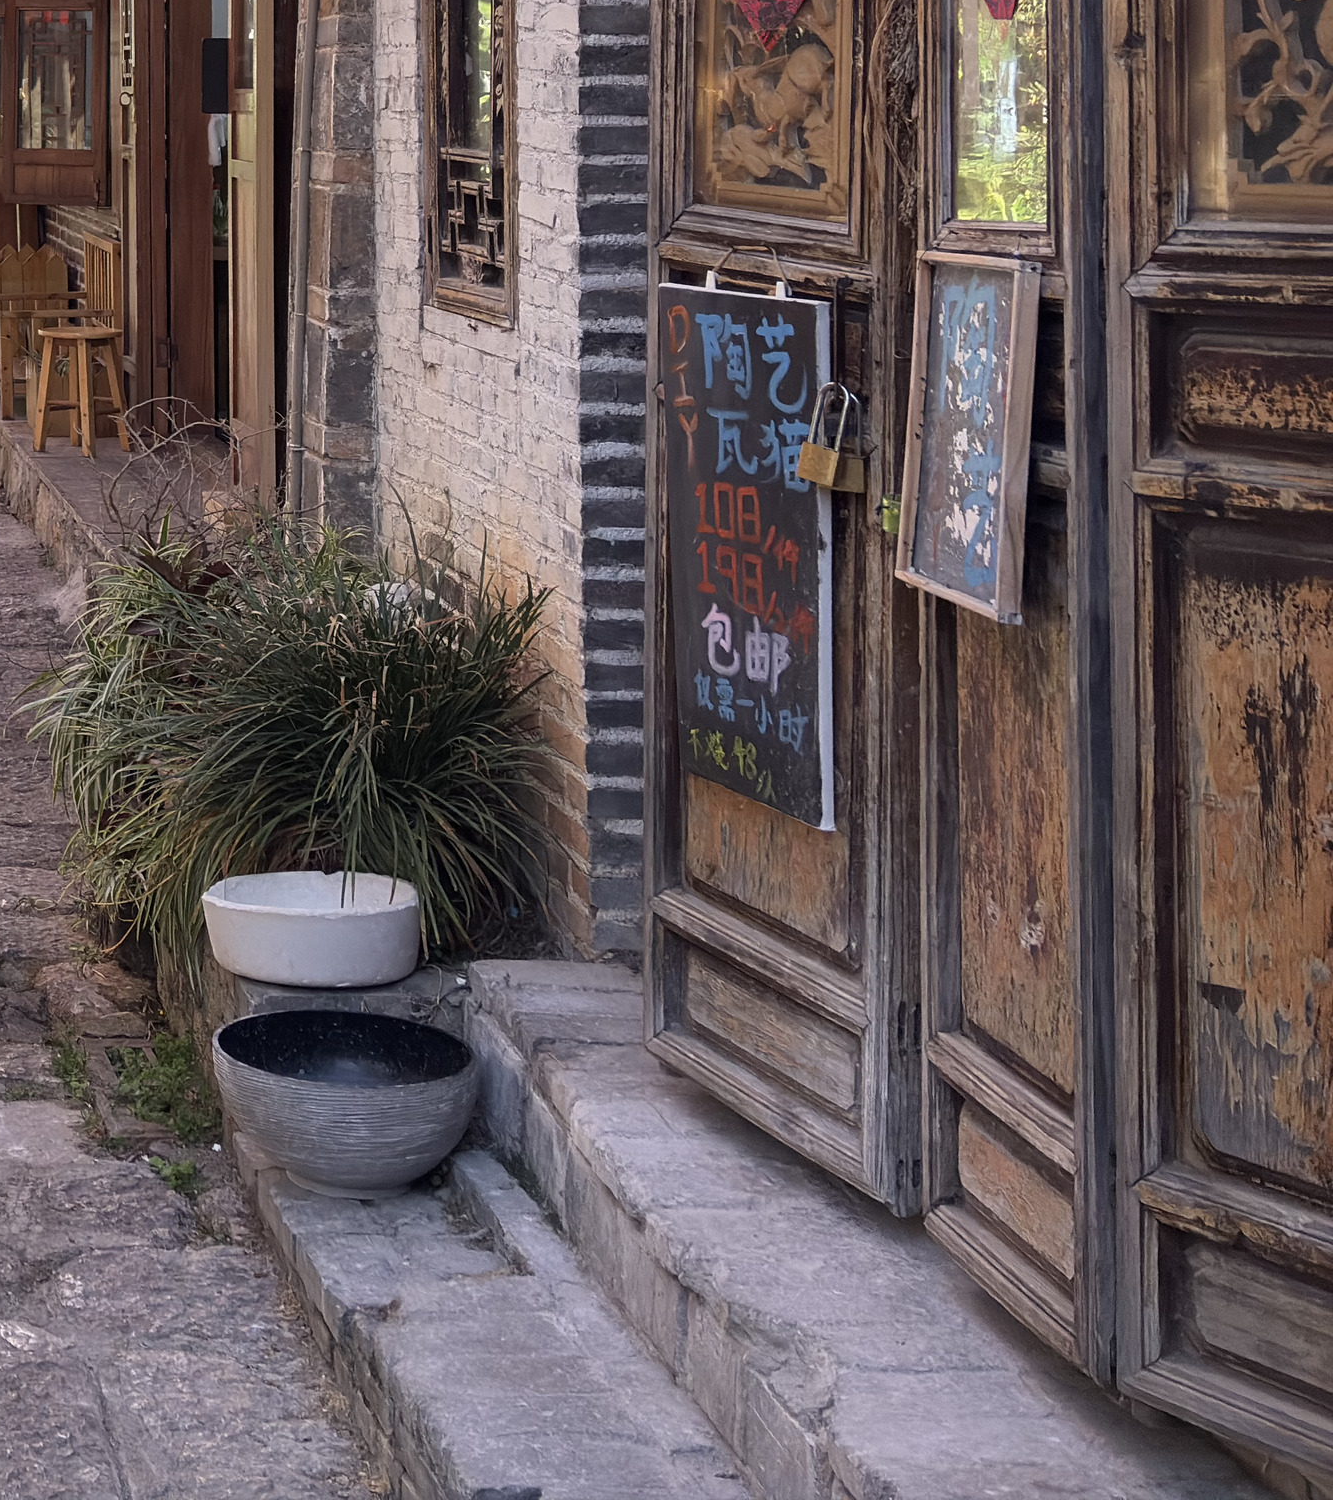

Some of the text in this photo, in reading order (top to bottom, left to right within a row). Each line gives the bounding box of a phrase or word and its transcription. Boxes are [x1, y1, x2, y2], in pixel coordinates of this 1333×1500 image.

[667, 305, 699, 472] DIY
[695, 313, 808, 414] 陶艺
[706, 406, 811, 493] 瓦猫
[701, 603, 791, 696] 包邮
